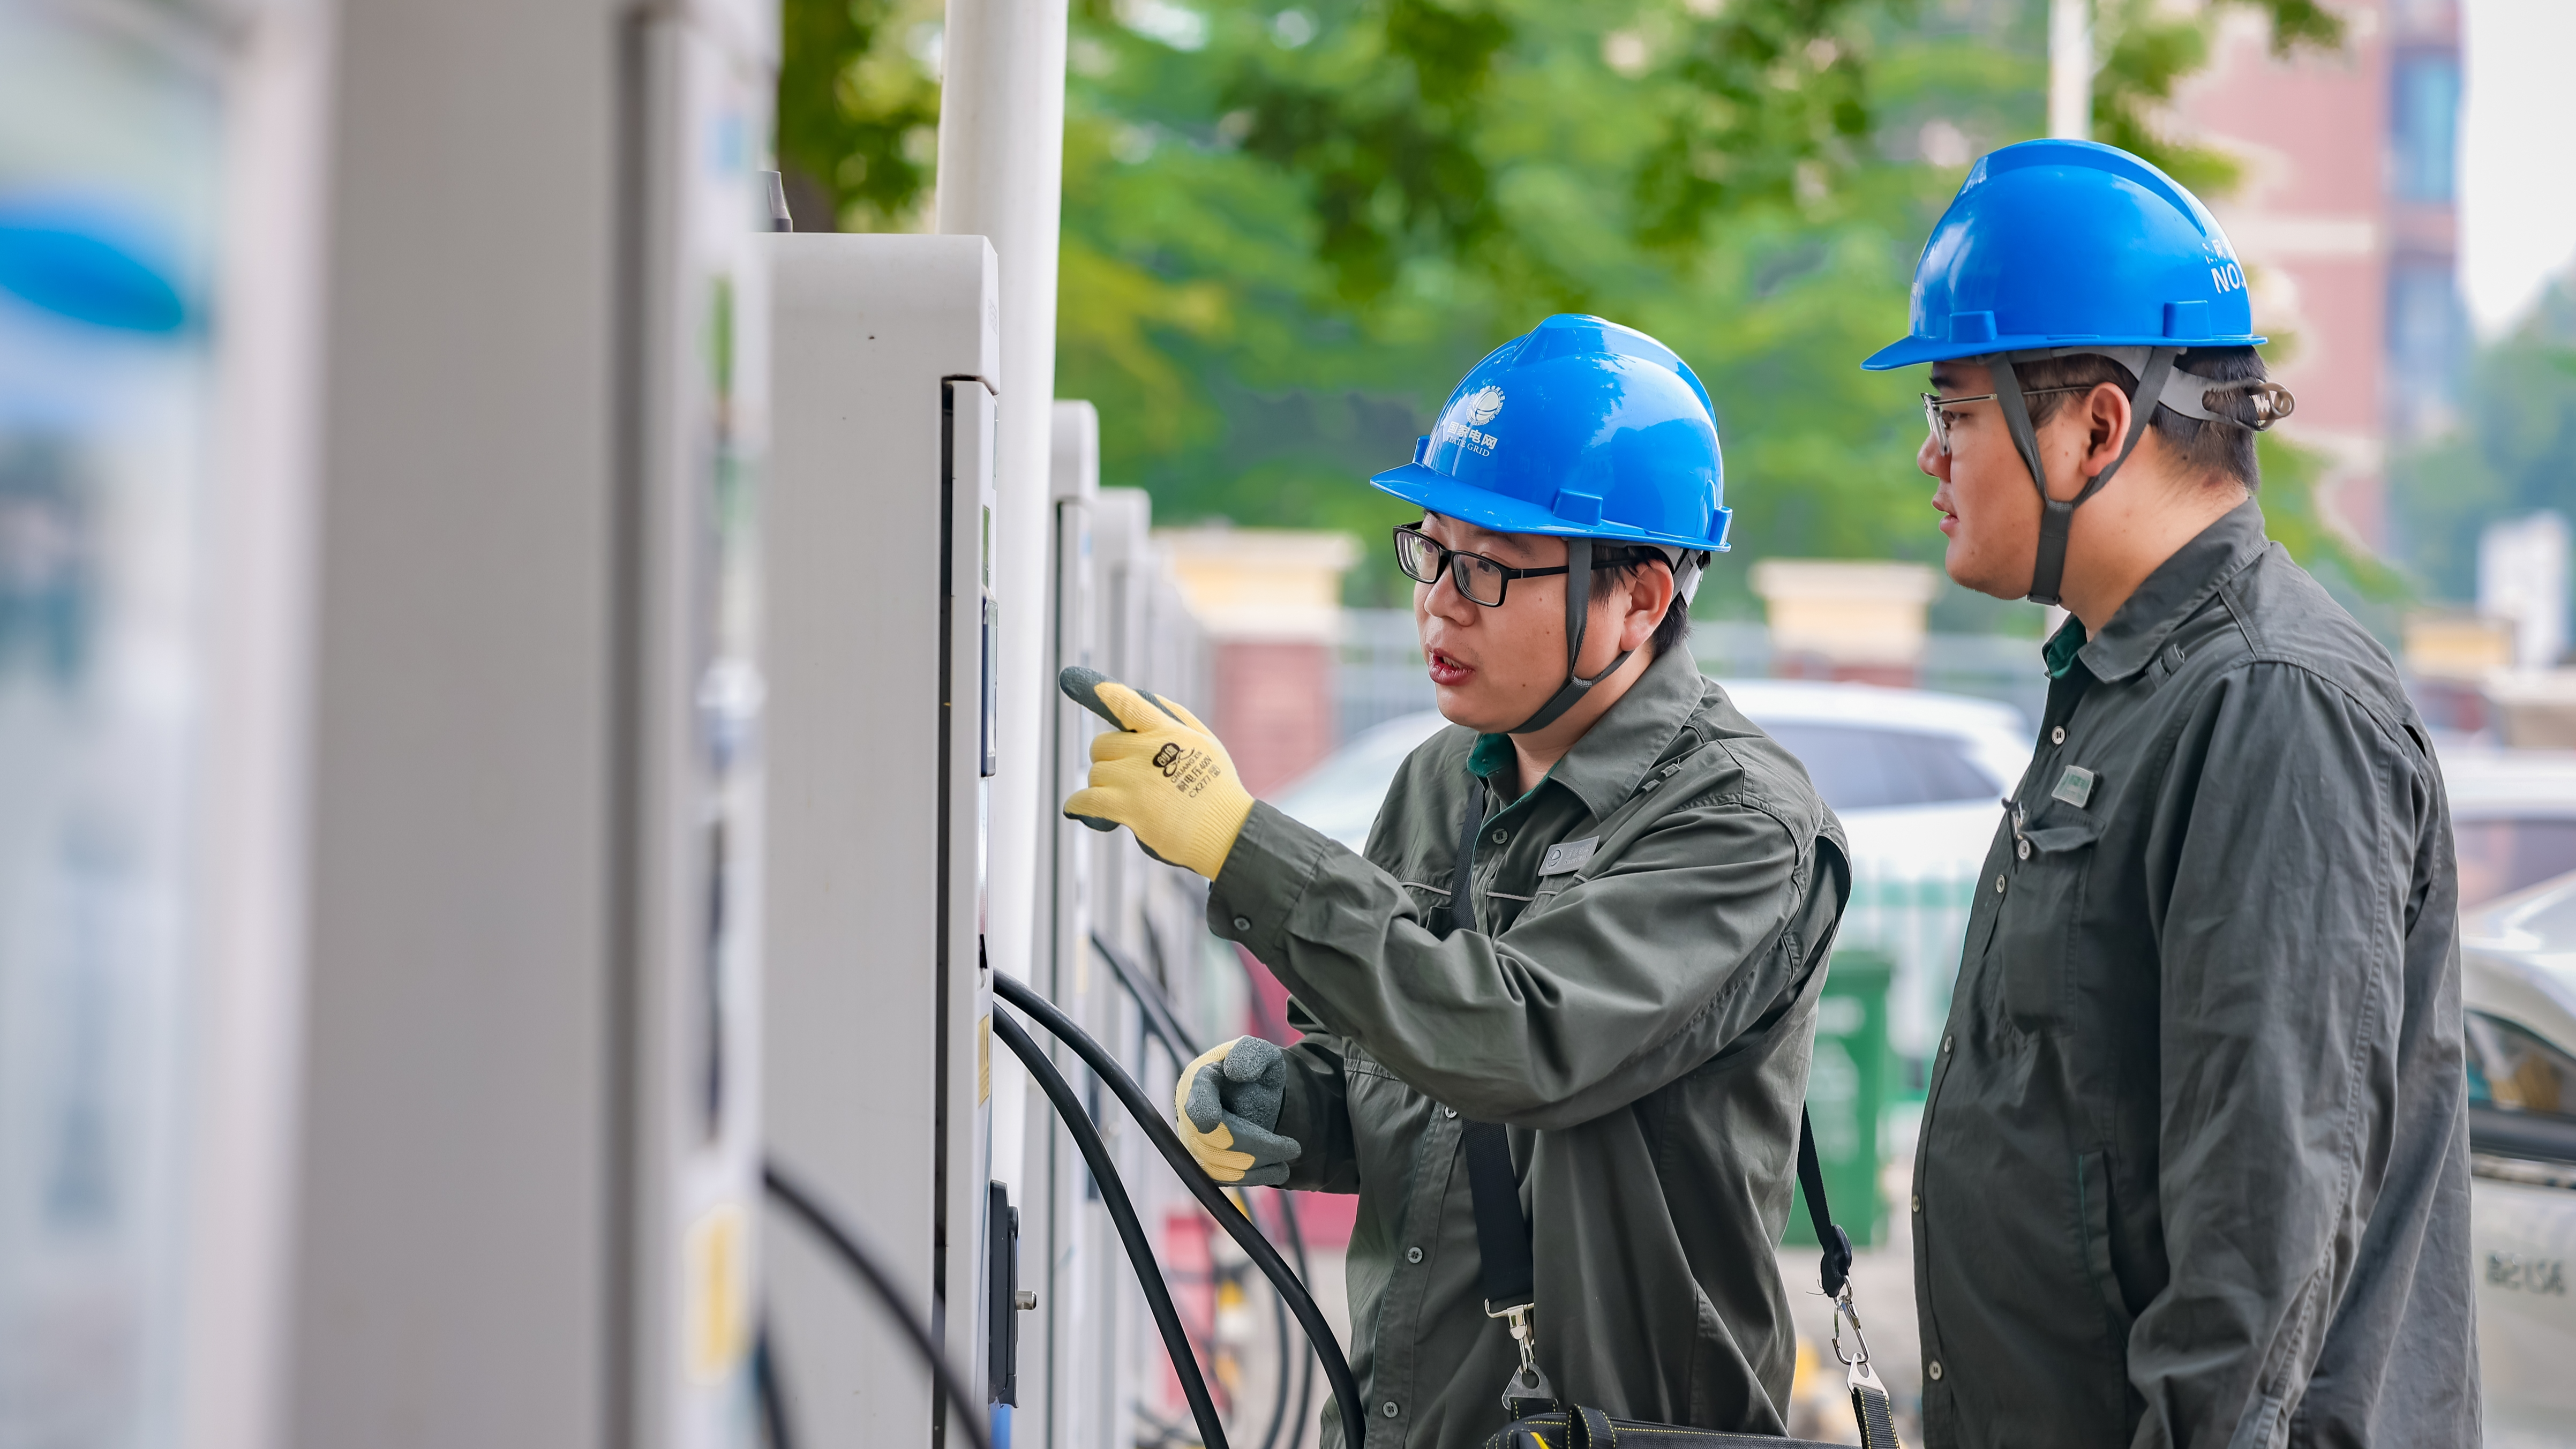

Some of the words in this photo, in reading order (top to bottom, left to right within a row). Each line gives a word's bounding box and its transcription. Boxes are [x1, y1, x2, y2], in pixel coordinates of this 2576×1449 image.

[1445, 434, 1467, 448] STATE
[1467, 443, 1490, 456] GRID
[1447, 421, 1498, 450] 国家电网
[1170, 757, 1195, 783] CHUANG
[1189, 775, 1211, 798] CX277
